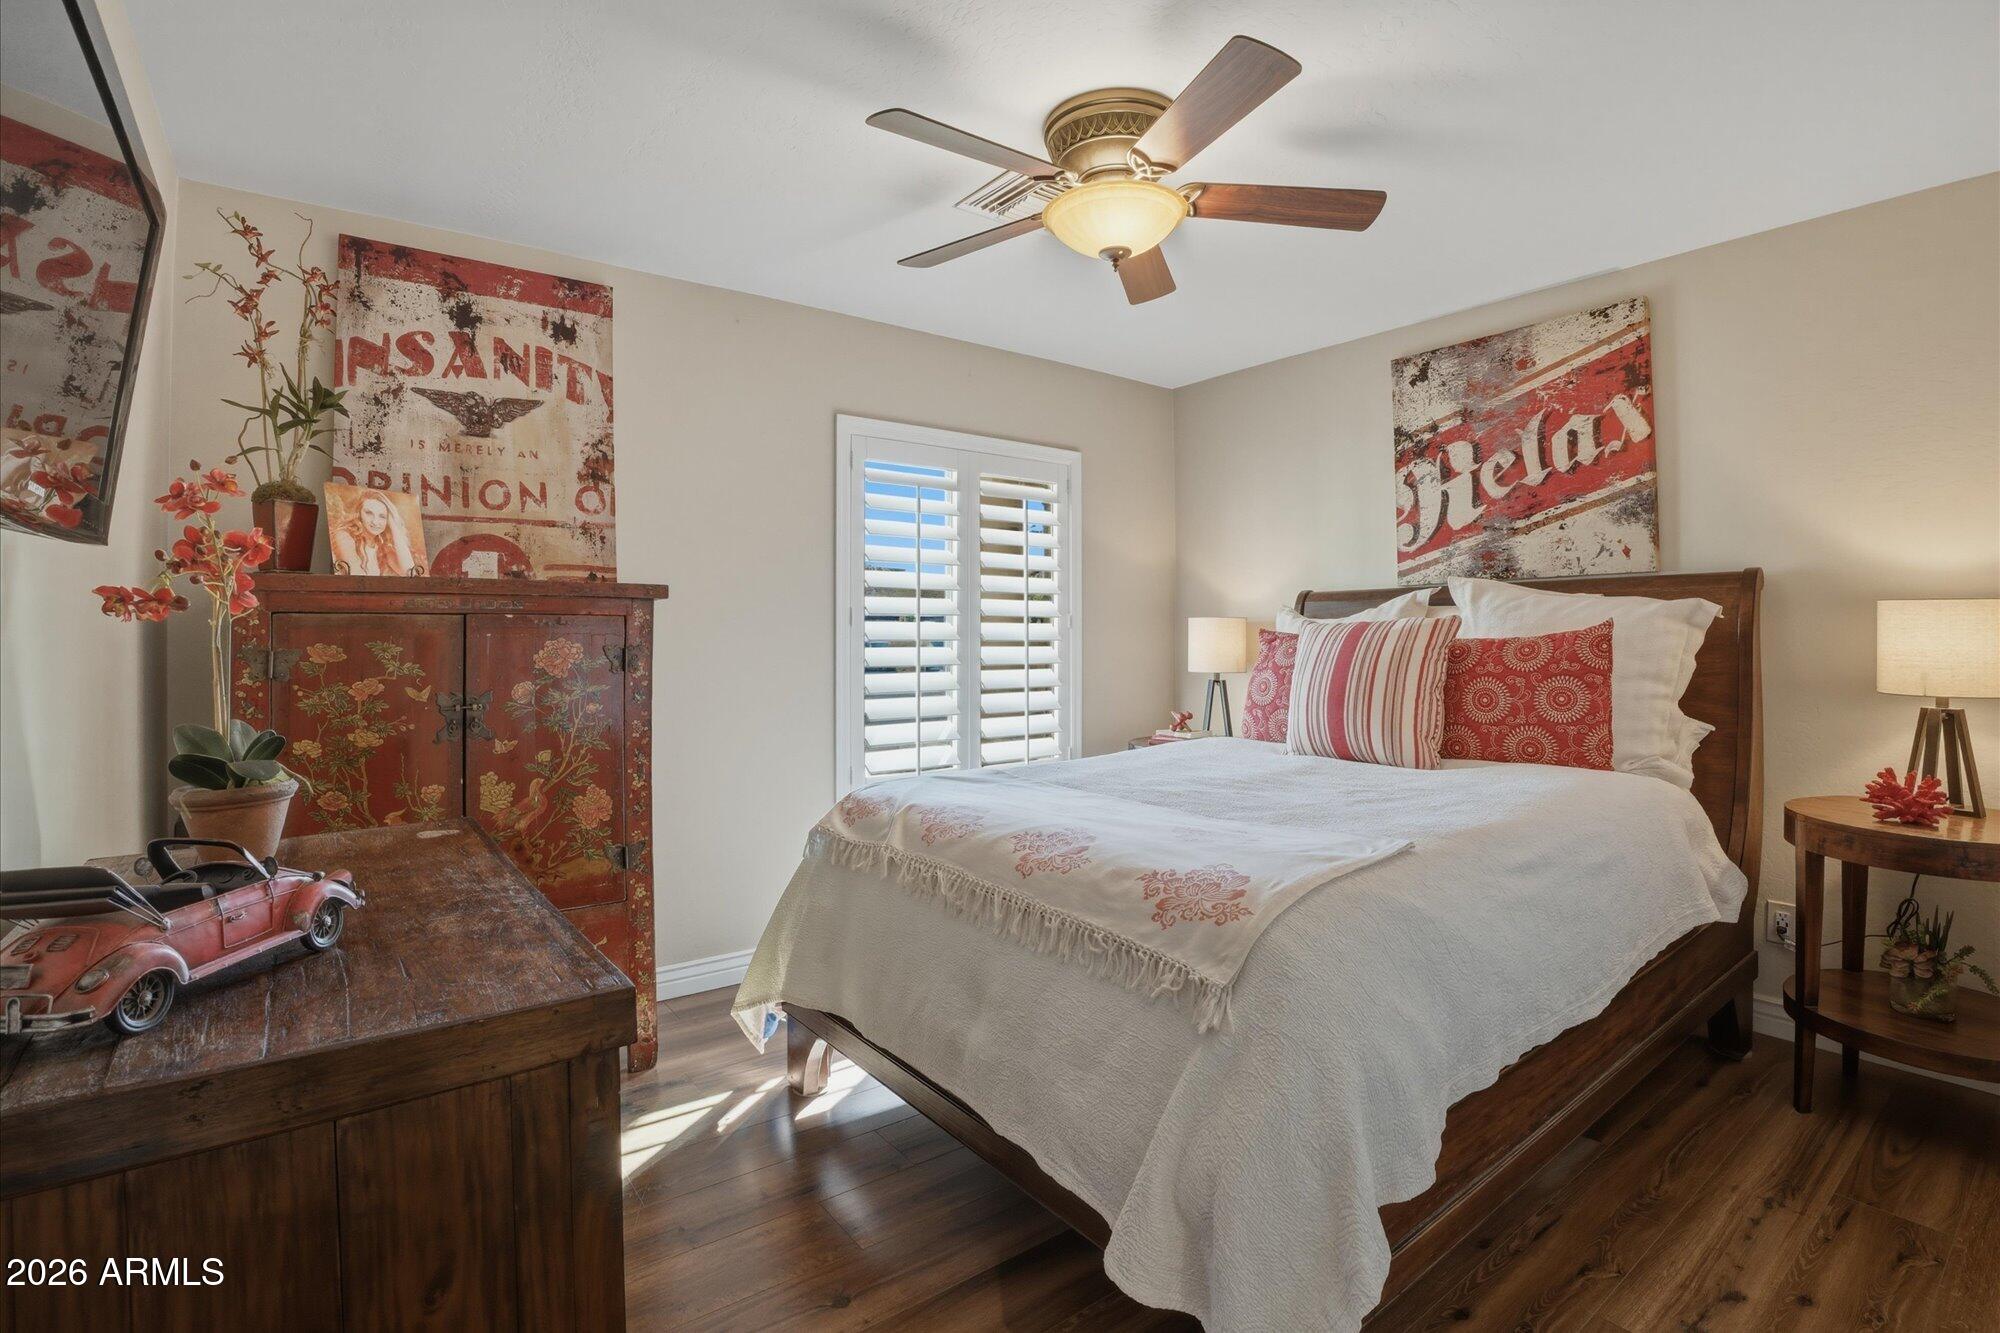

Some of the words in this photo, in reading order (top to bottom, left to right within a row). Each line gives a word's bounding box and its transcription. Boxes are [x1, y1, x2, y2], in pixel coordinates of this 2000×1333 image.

[410, 439, 426, 450] IS
[439, 442, 505, 456] MERELY
[517, 450, 539, 460] AN
[1395, 385, 1652, 552] Relax
[332, 466, 548, 514] PINION
